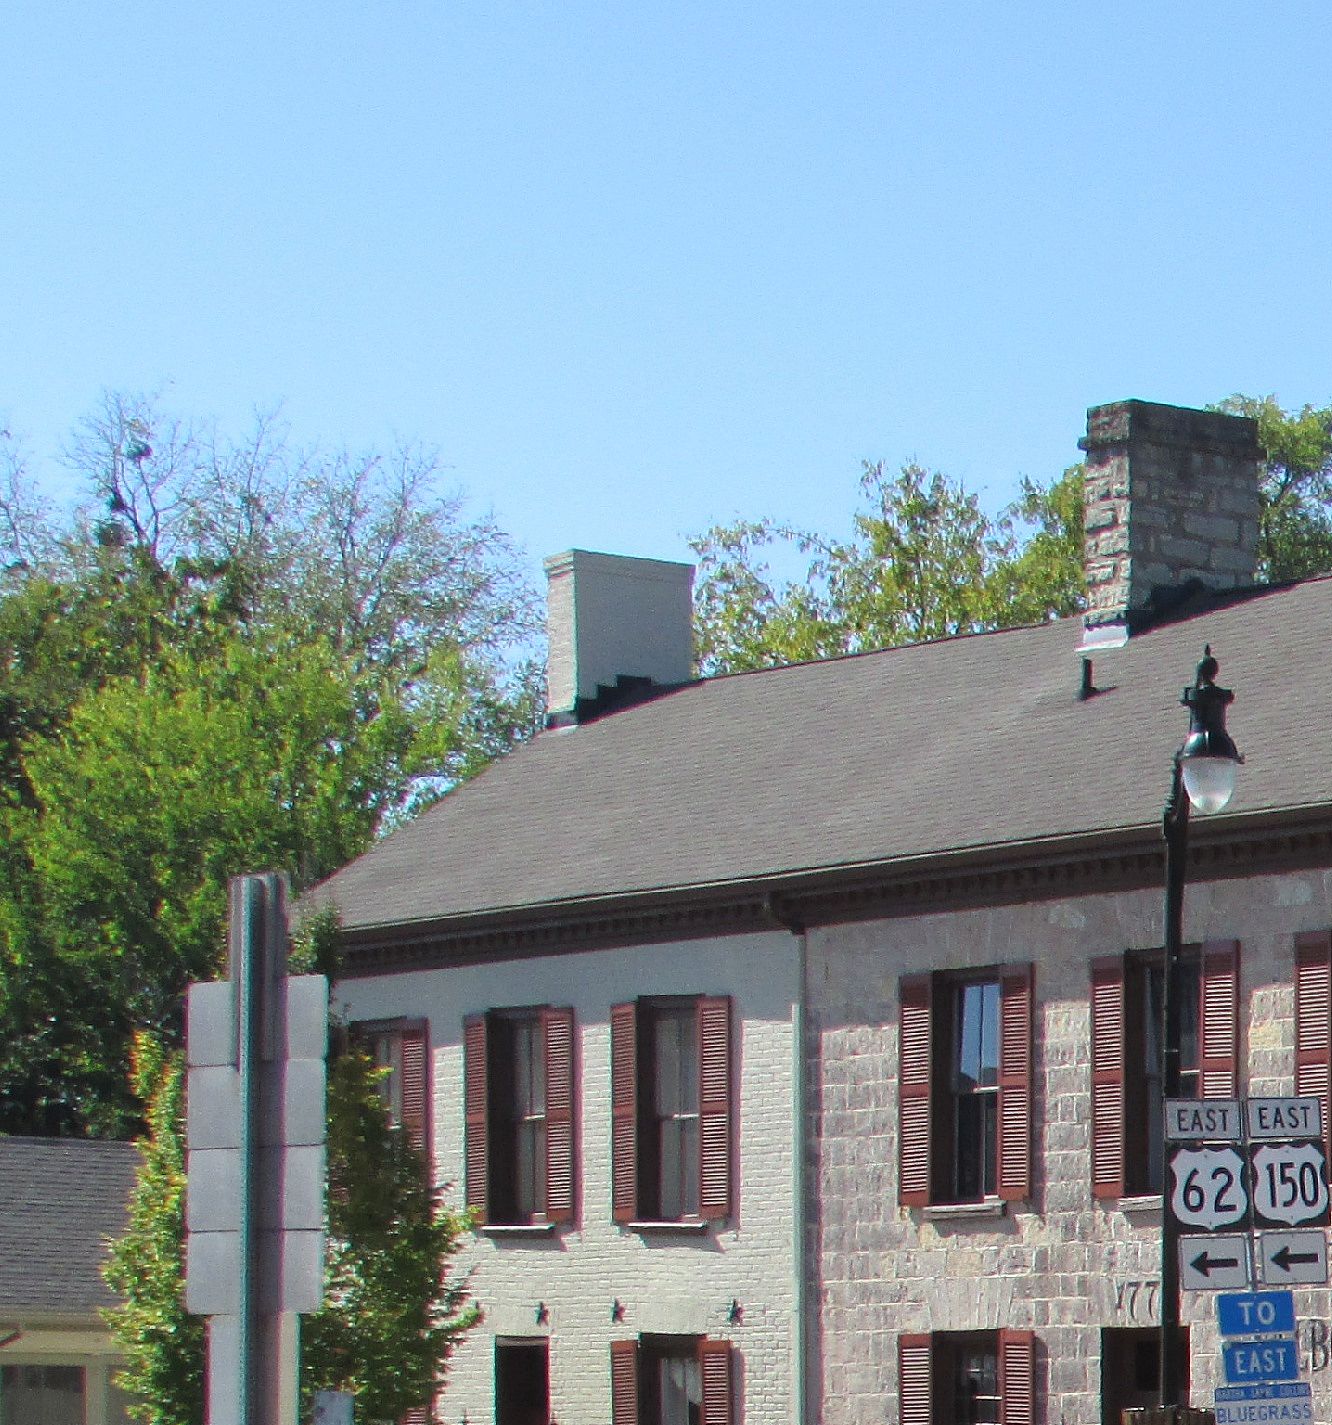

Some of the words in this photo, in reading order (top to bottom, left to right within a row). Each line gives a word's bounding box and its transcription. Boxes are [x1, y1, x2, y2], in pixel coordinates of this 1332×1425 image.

[1177, 1109, 1229, 1132] EAST
[1258, 1106, 1310, 1130] EAST
[1183, 1167, 1237, 1213] 62
[1266, 1161, 1319, 1208] 150
[1116, 1281, 1161, 1320] 177
[1238, 1301, 1276, 1326] TO
[1235, 1347, 1287, 1375] EAST
[1216, 1404, 1312, 1423] BLUEGRASS
